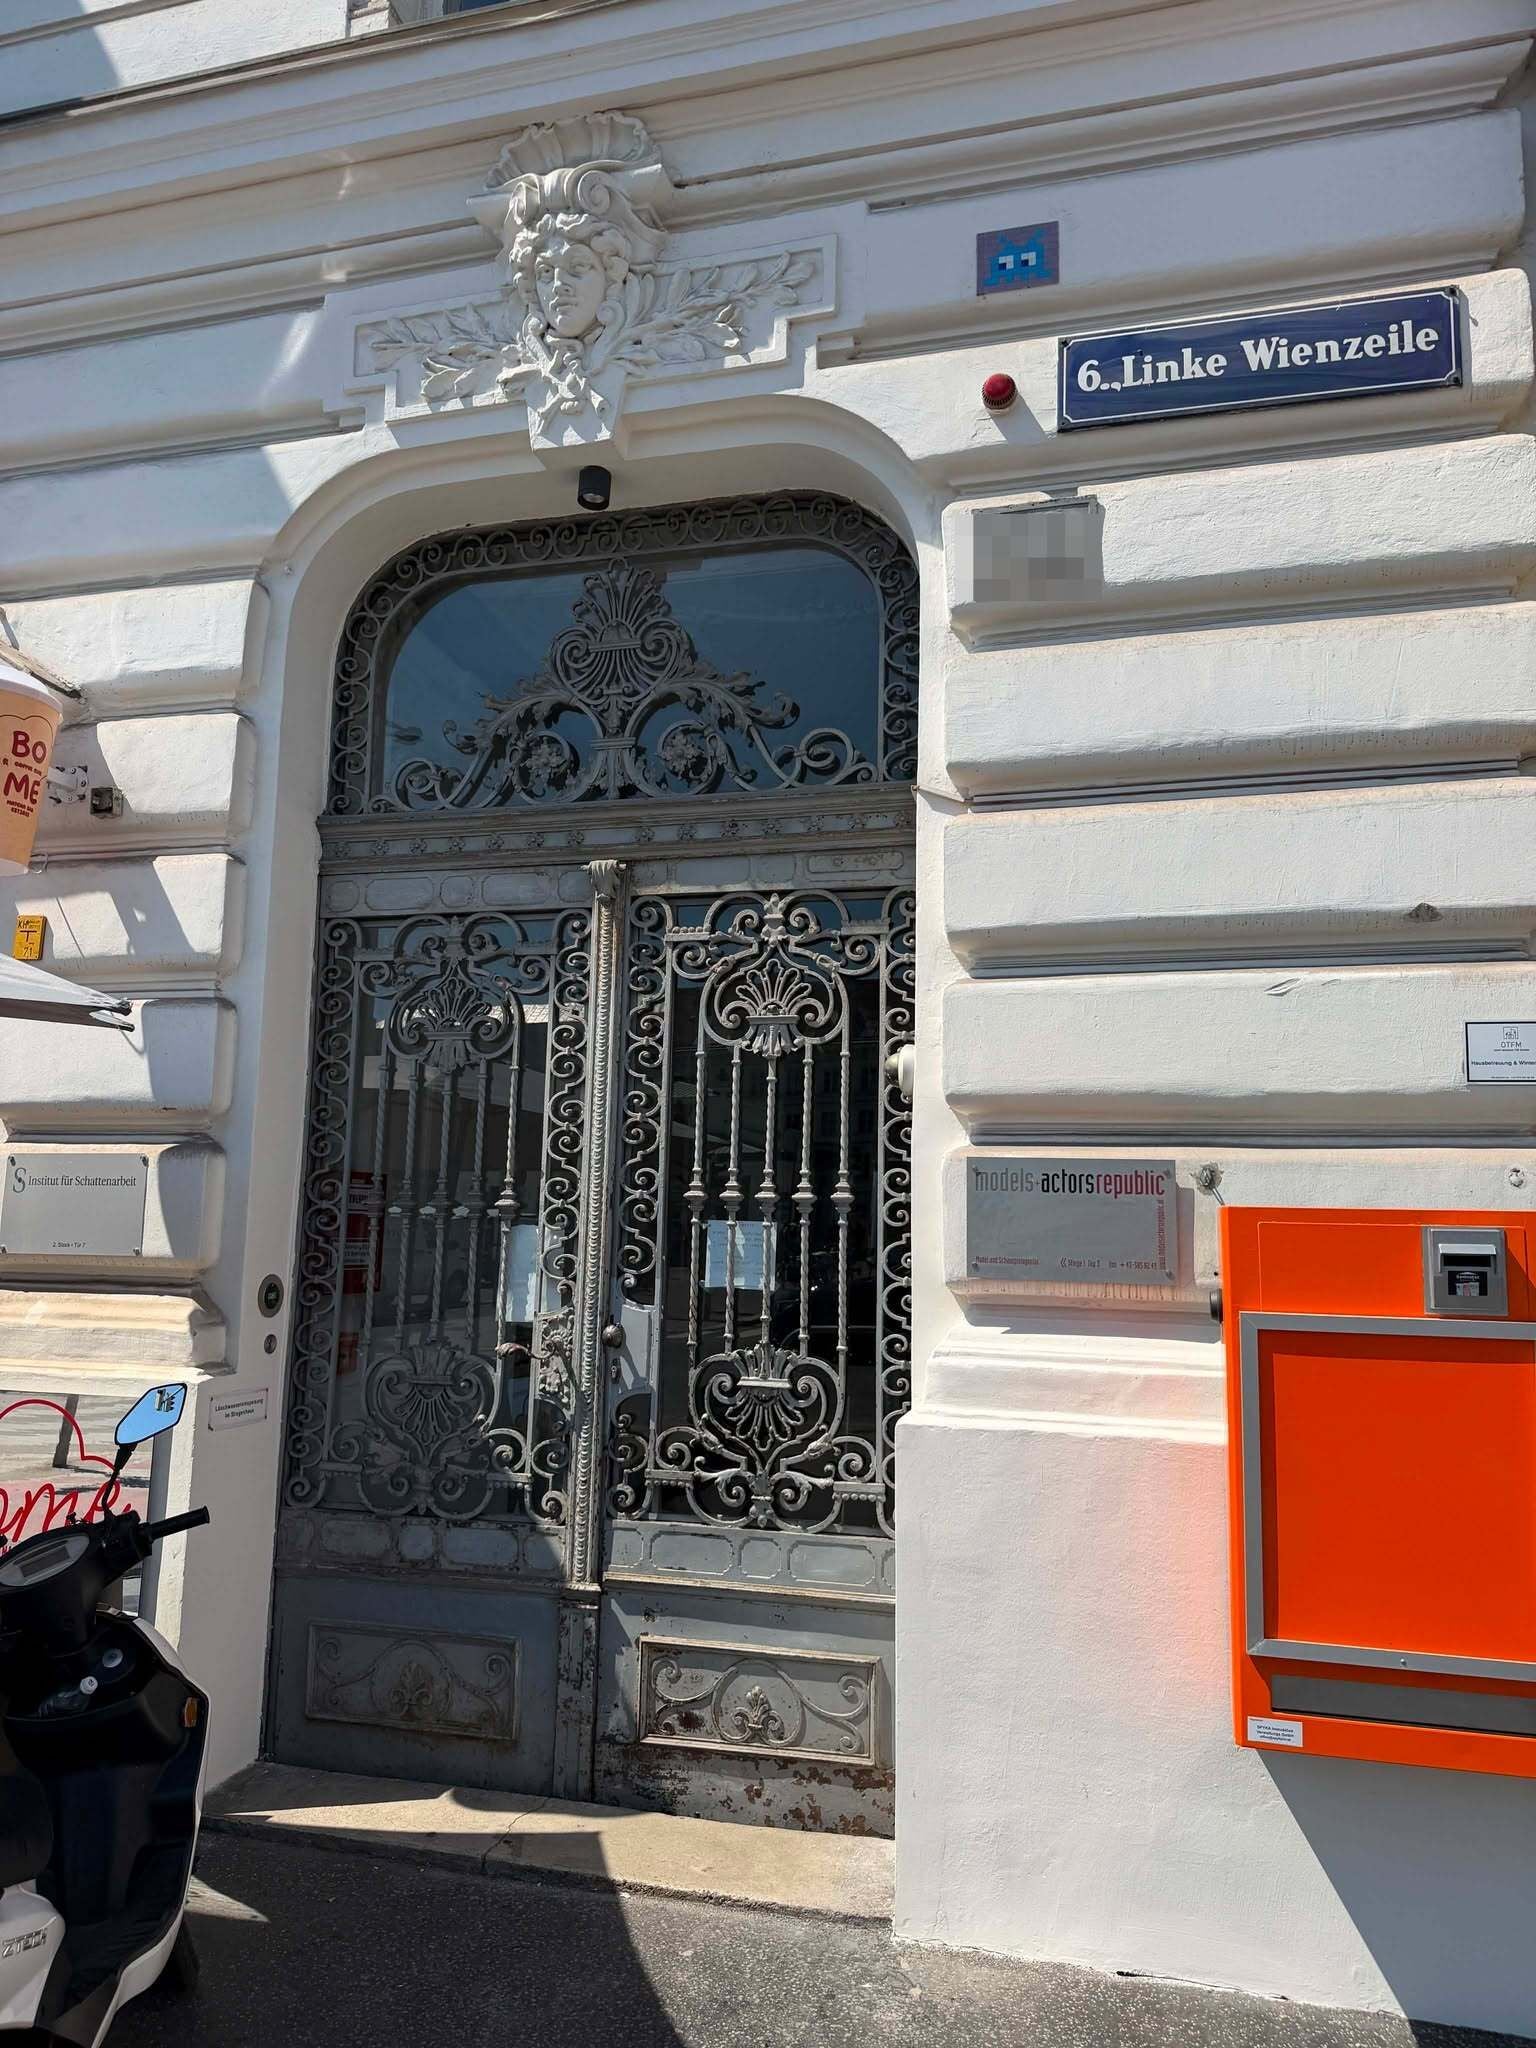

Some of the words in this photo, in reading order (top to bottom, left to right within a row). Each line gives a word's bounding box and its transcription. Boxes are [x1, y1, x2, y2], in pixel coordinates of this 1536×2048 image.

[1122, 347, 1228, 388] Linke
[1240, 319, 1440, 373] Wienzeile
[12, 730, 47, 764] BO
[3, 772, 41, 805] ME
[28, 1175, 59, 1186] Institut
[60, 1175, 74, 1187] für
[75, 1175, 137, 1187] Schattenarbeit
